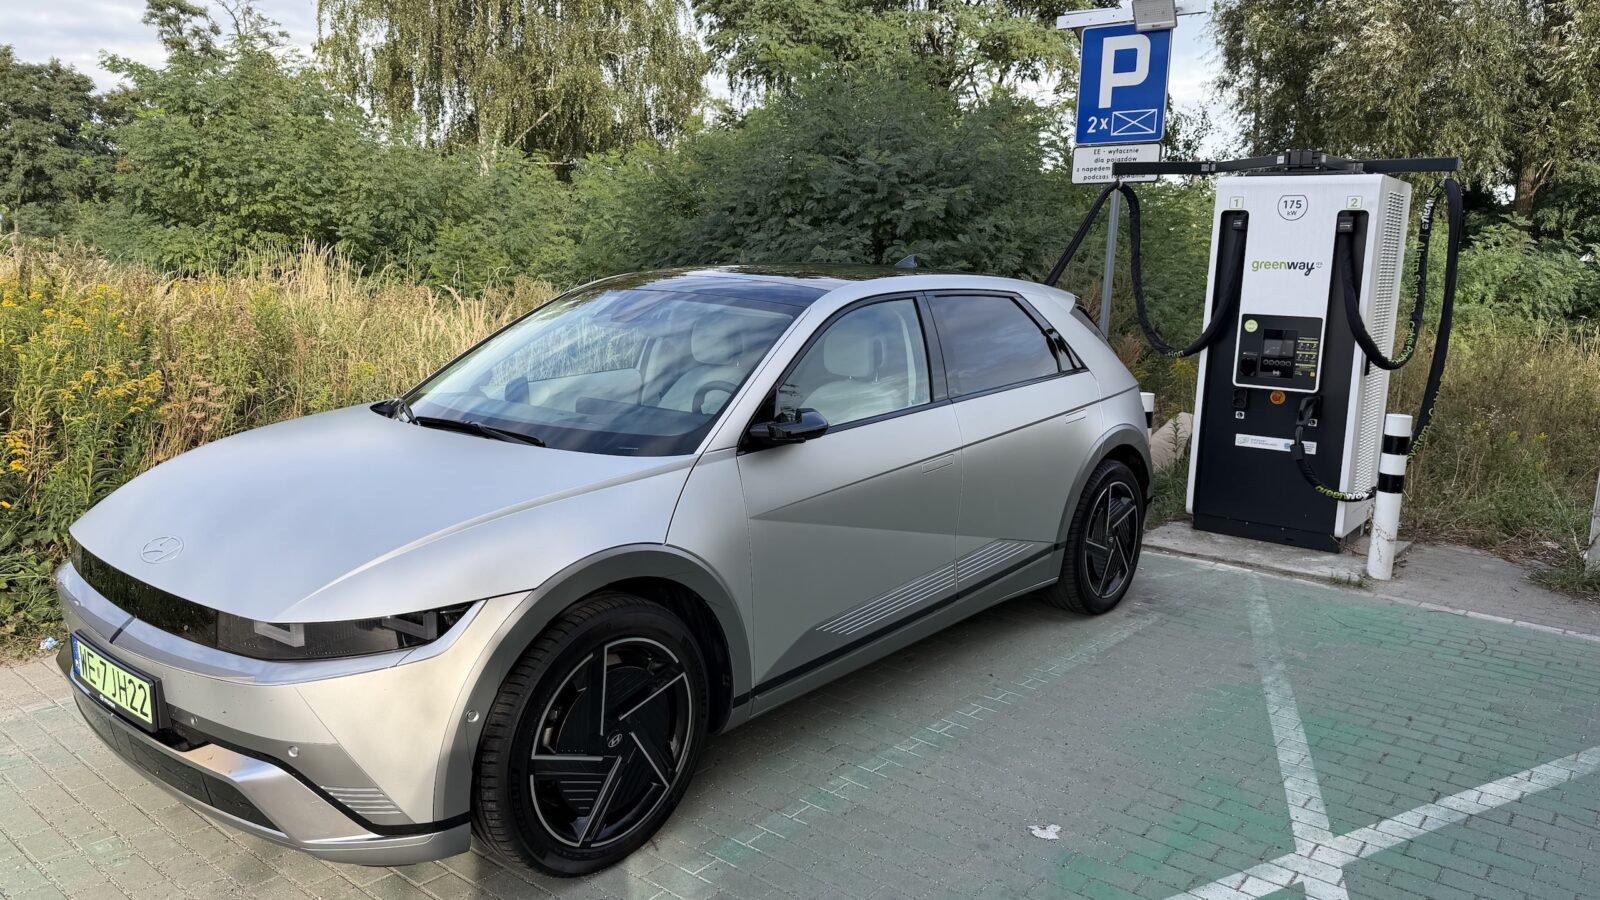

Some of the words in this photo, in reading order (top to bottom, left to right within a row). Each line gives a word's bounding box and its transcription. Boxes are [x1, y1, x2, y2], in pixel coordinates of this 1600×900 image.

[1098, 34, 1151, 109] P
[1106, 156, 1138, 164] pojazdów
[1234, 199, 1239, 207] 1
[1283, 200, 1302, 209] 175
[1350, 198, 1358, 207] 2
[1251, 260, 1315, 277] greenway
[79, 645, 97, 686] WE
